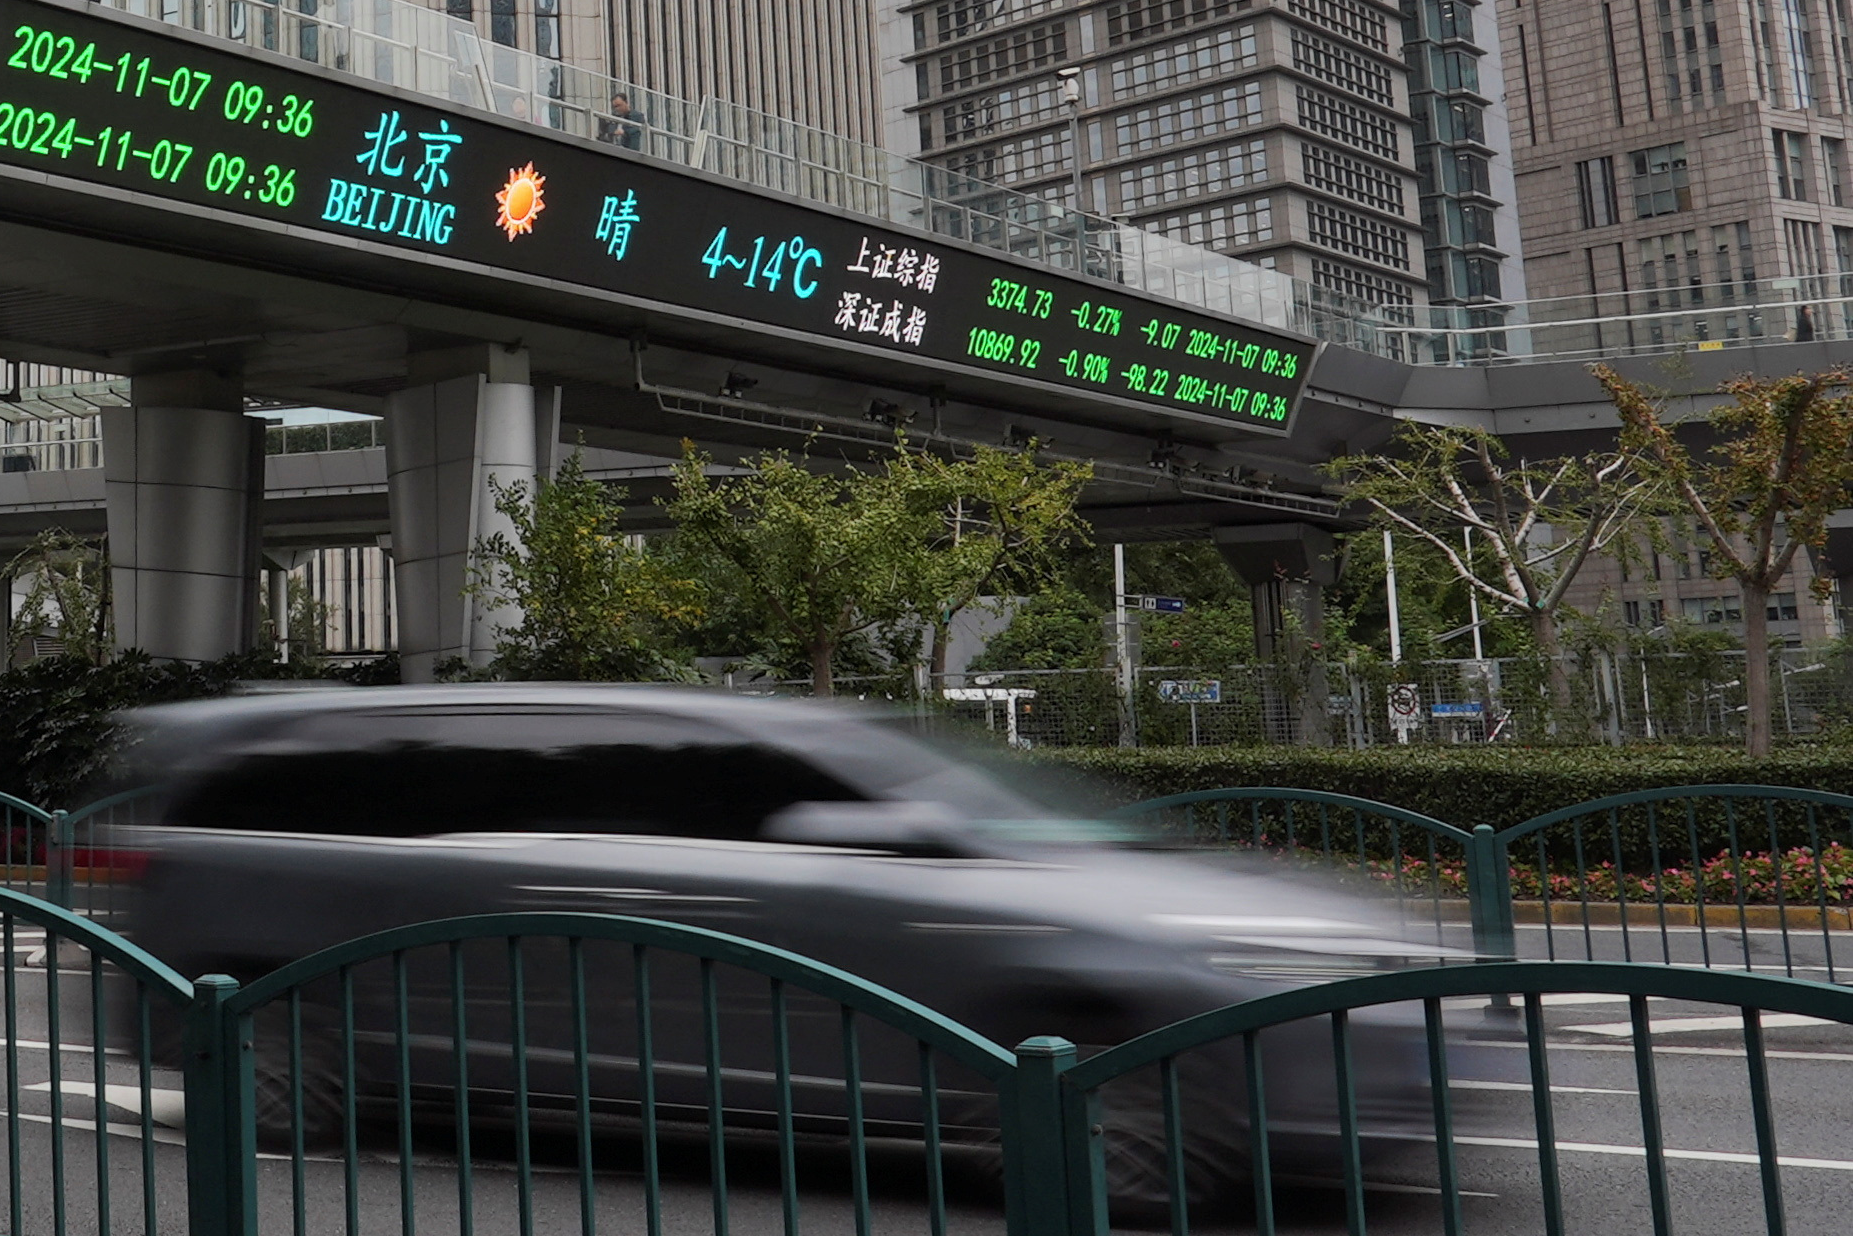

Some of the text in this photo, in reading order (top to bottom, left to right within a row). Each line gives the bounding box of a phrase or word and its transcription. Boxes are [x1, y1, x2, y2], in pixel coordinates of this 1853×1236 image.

[7, 26, 213, 110] 2024-11-07
[223, 81, 314, 138] 09:36
[205, 152, 297, 207] 09:36
[356, 111, 463, 194] 北京
[322, 179, 457, 244] BEIJING
[596, 190, 641, 260] 晴
[847, 237, 1298, 378] 上证综指 3374.73 -0.27% -9.07 2024-11-07 09:36
[834, 291, 1287, 421] 深证成指 10869.92 -0.90% -98.22 2024-11-07 09:36
